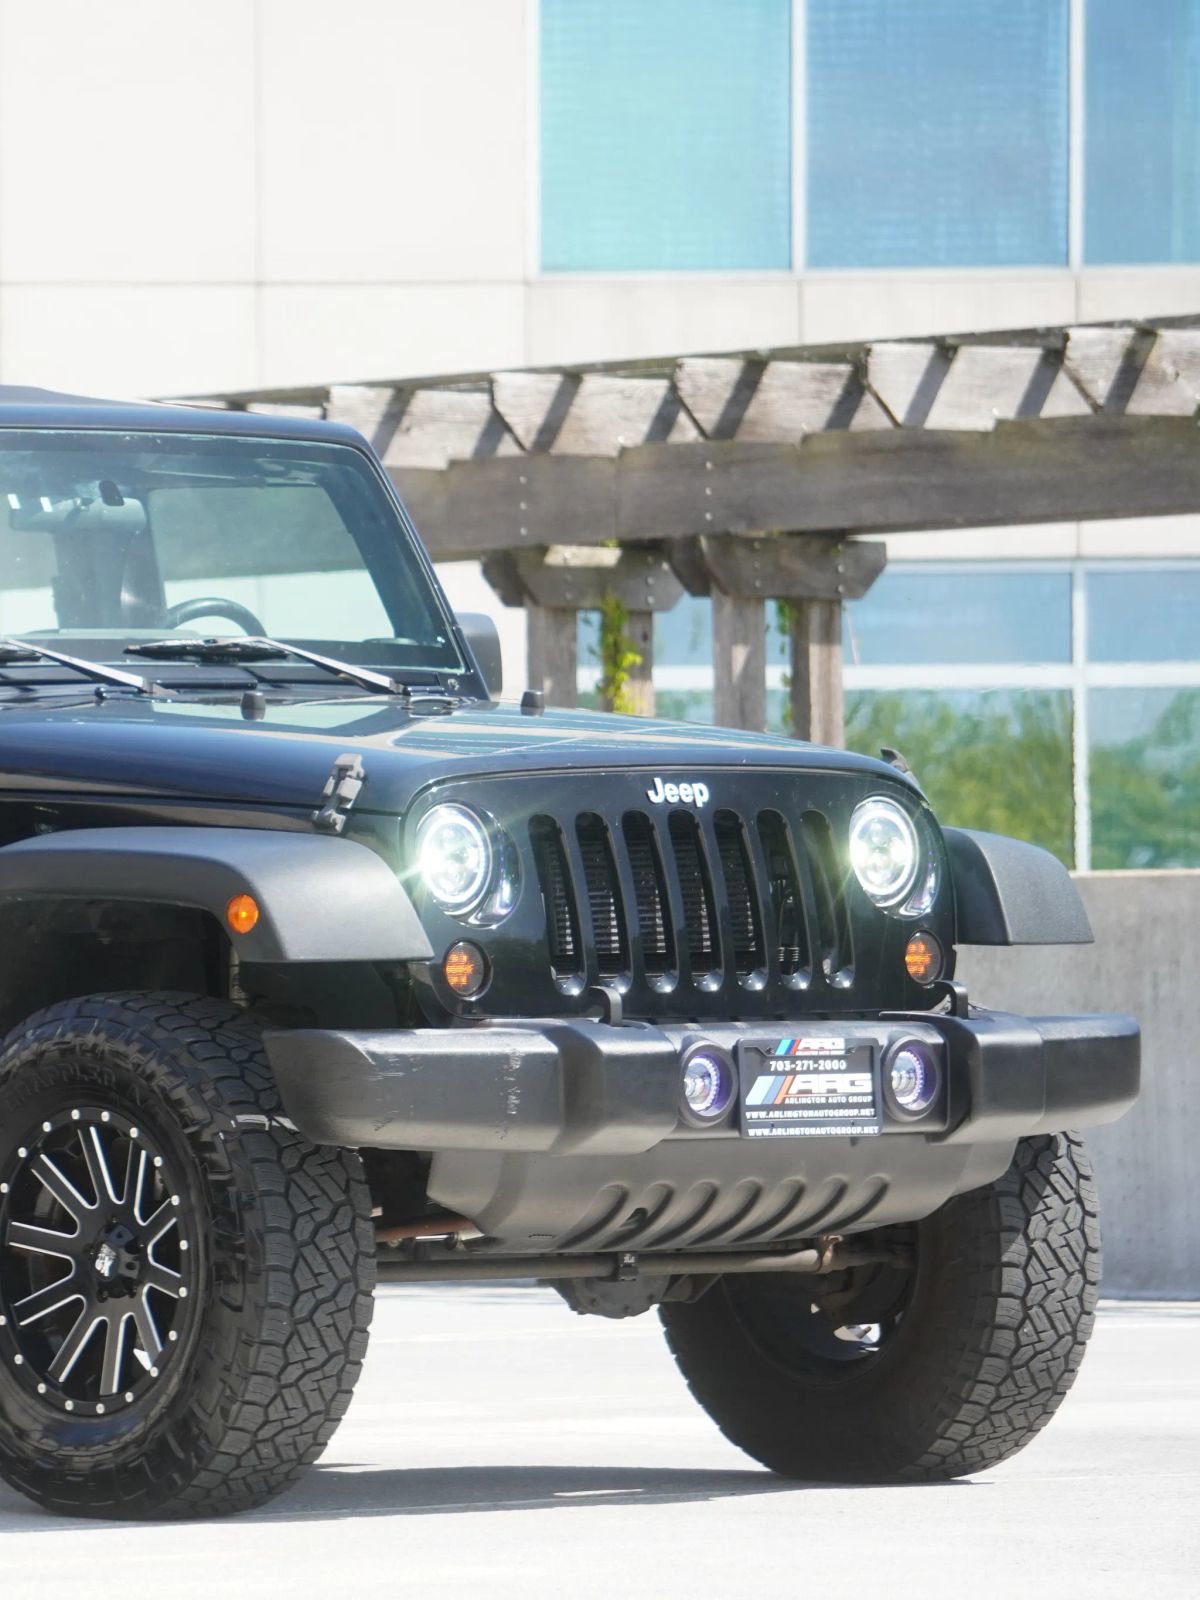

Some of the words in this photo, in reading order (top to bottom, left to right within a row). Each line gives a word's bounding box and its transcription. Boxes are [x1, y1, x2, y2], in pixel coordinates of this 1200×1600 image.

[647, 777, 710, 808] Jeep
[770, 1059, 847, 1071] 703-271-2000
[784, 1096, 826, 1105] ARLINGTON
[828, 1096, 847, 1104] AUTO
[848, 1095, 873, 1103] GROUP
[748, 1126, 879, 1137] WWW.ARLINGTONAUTOGROUP.NET
